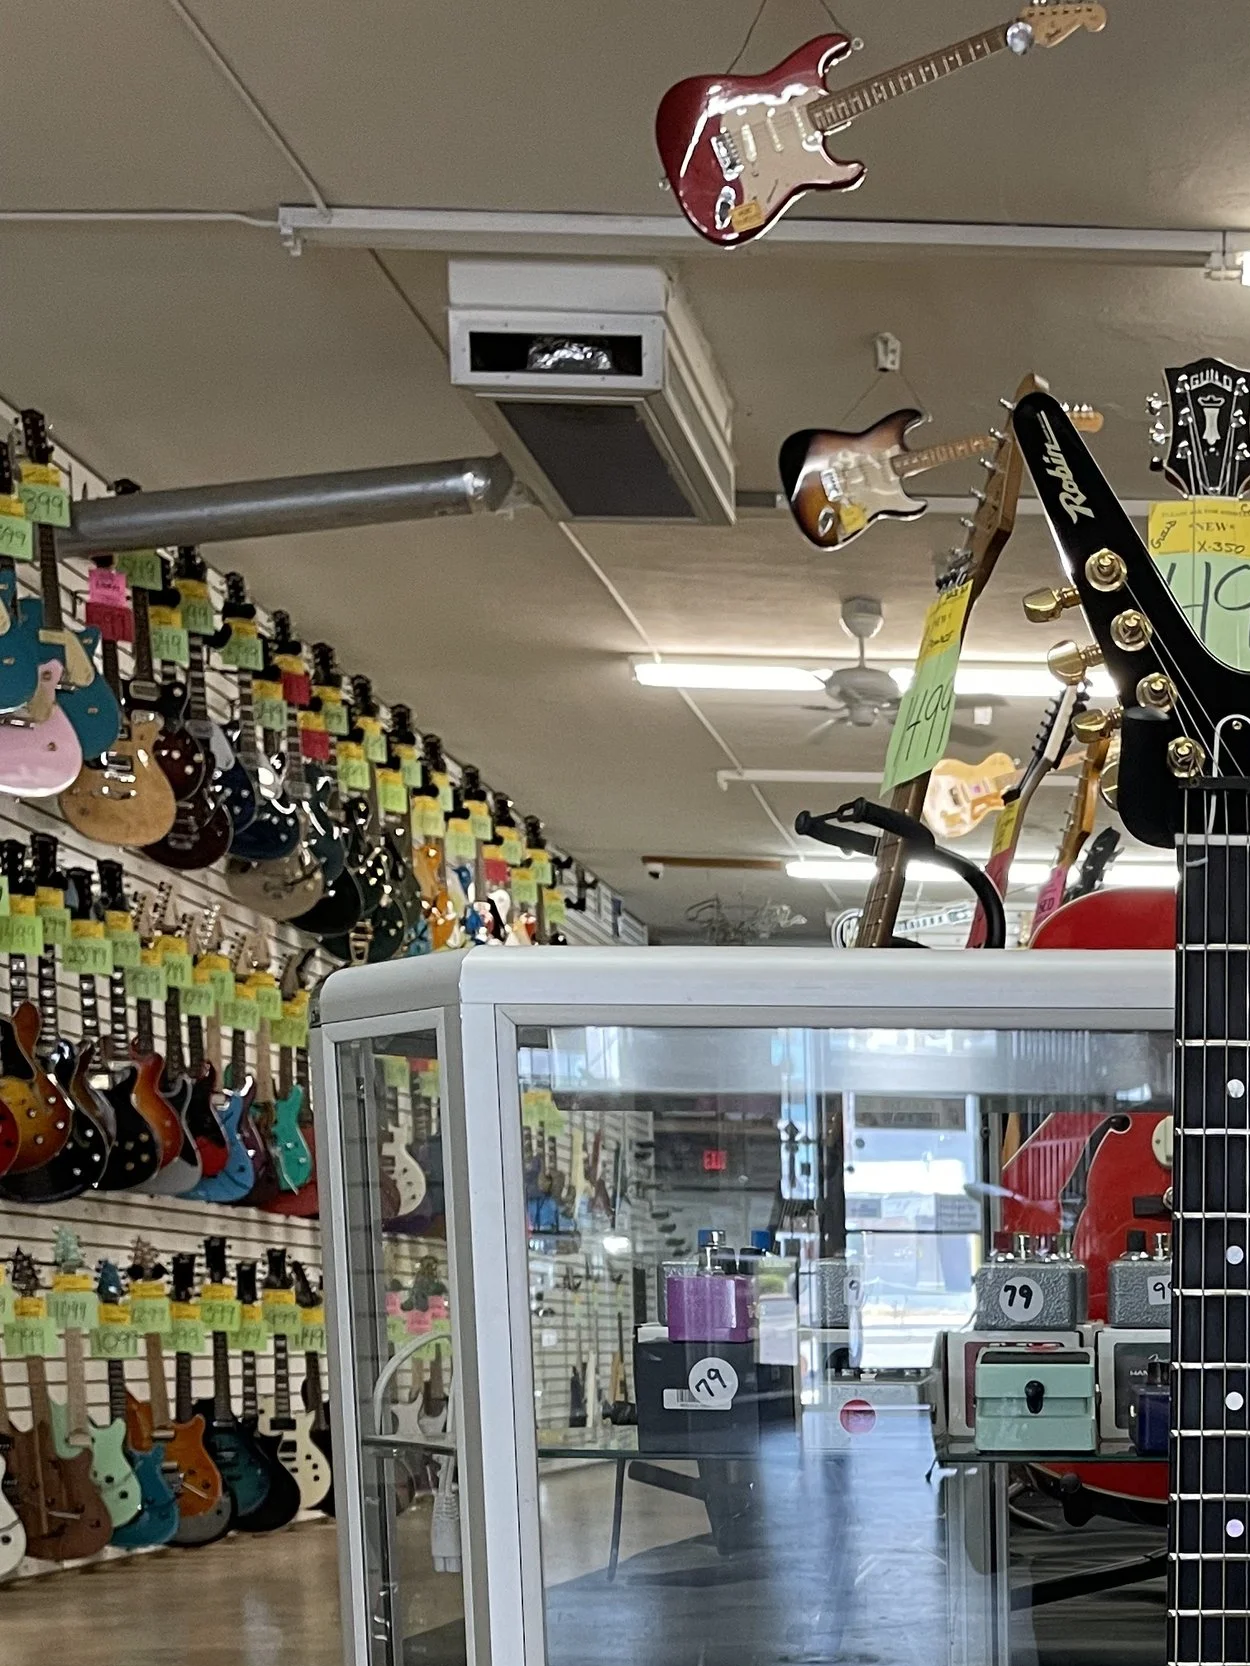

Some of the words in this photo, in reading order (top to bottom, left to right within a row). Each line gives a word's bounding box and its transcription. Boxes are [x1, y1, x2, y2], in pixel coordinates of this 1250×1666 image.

[1190, 368, 1233, 393] GUILD
[1036, 411, 1096, 525] Robin
[1003, 1283, 1034, 1310] 79
[695, 1368, 727, 1397] 79
